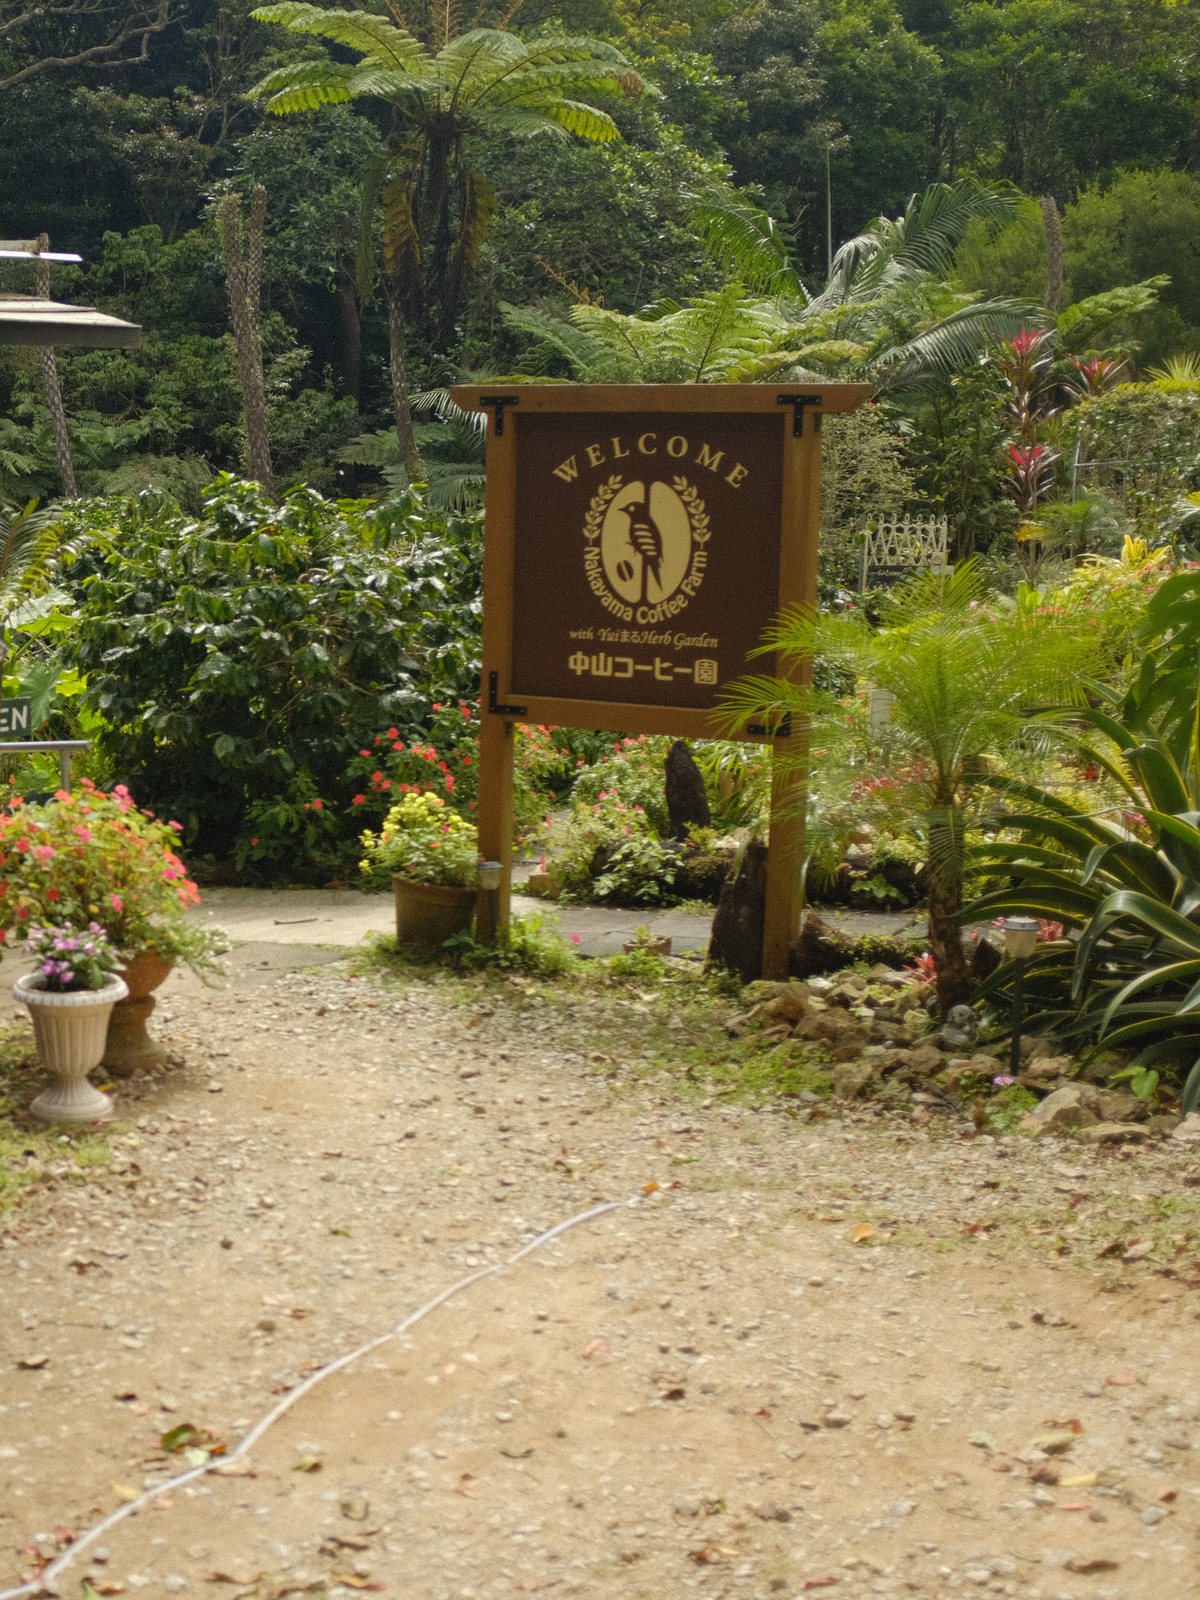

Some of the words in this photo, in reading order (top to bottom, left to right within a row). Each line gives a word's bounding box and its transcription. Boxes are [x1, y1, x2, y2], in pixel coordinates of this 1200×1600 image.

[552, 432, 749, 489] WELCOME
[584, 547, 633, 622] Nakayama
[635, 593, 689, 625] Coffee
[680, 551, 708, 597] Farm
[569, 627, 594, 640] with
[673, 632, 719, 650] Garden
[568, 650, 718, 685] 中山コーヒー園
[0, 705, 28, 732] EN
